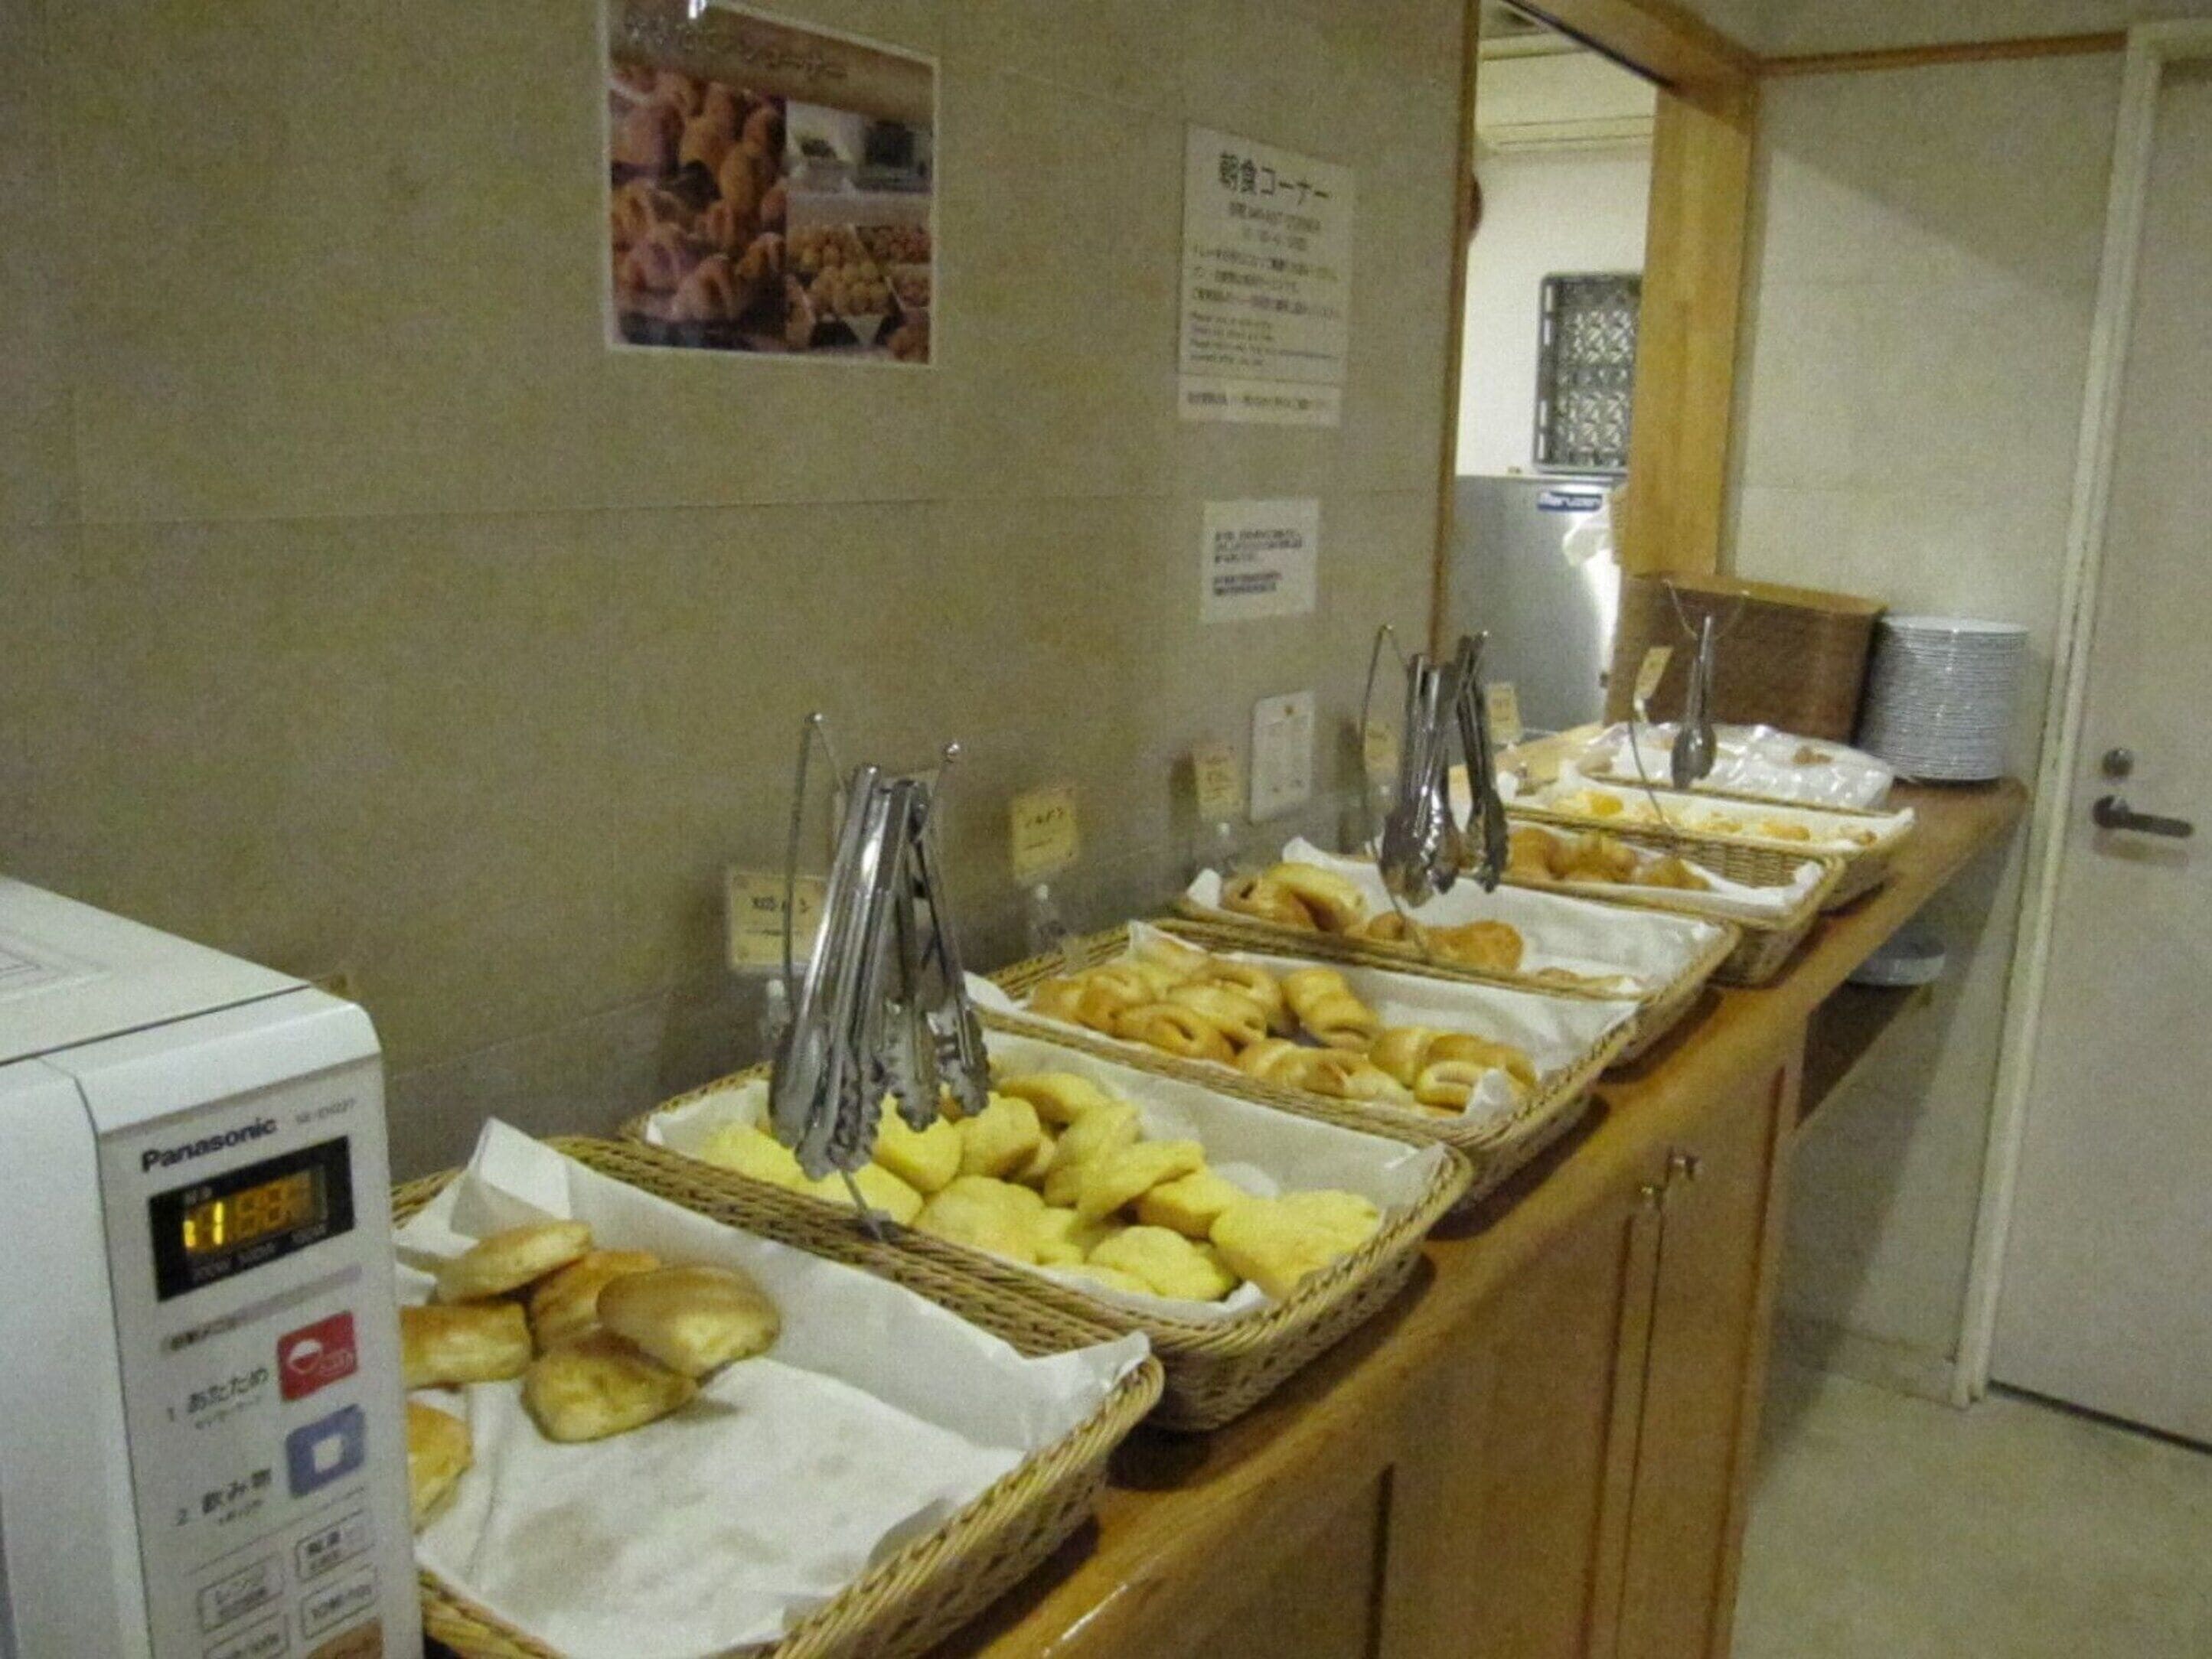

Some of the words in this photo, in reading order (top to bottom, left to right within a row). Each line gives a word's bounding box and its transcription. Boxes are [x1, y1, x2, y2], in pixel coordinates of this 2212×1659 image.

[1219, 152, 1330, 205] 朝食コーナー
[142, 1117, 278, 1172] Panasonic
[187, 1367, 269, 1413] あたため
